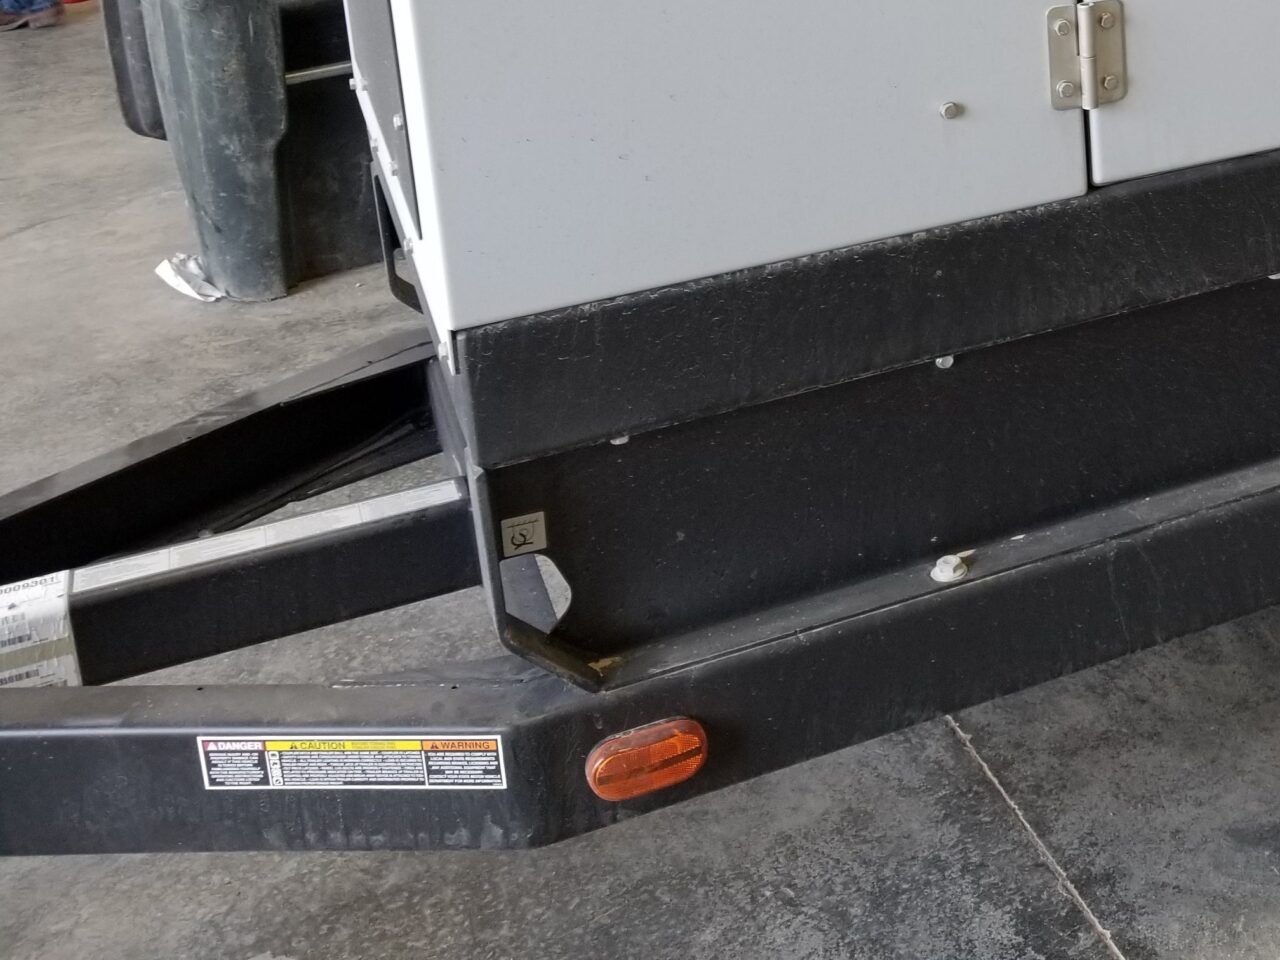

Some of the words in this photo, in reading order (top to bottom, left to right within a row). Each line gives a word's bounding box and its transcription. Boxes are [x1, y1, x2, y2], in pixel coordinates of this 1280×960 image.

[217, 741, 263, 751] DANGER
[300, 742, 346, 750] CAUTION
[440, 741, 490, 750] WARNING
